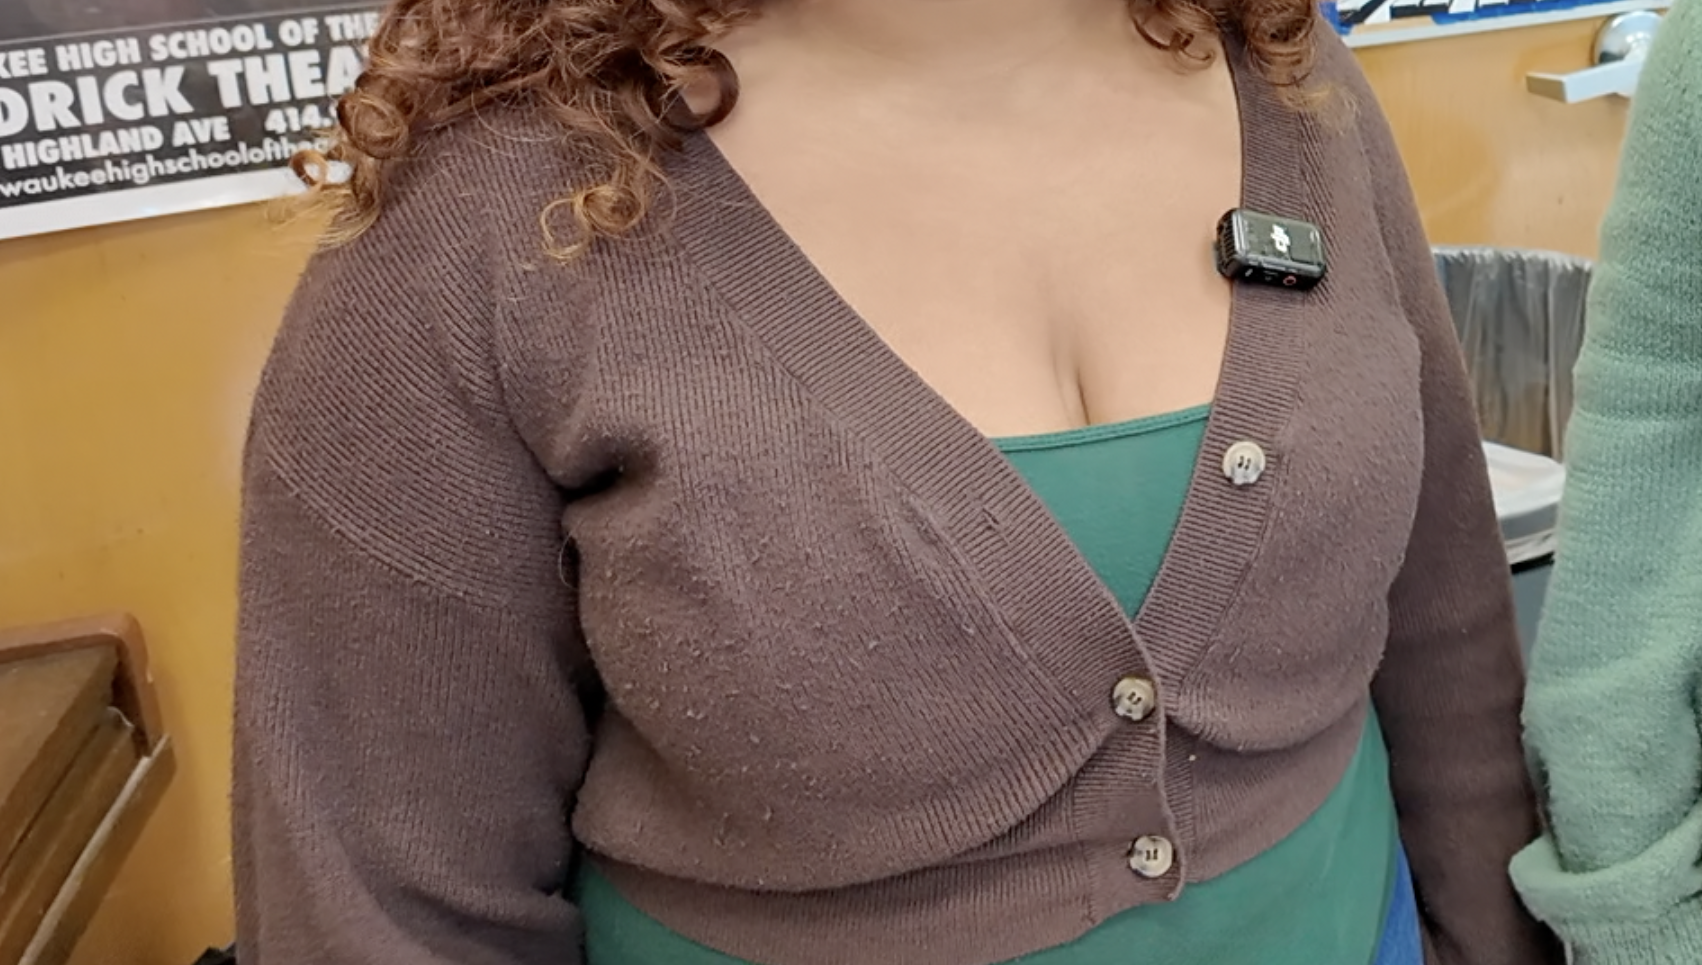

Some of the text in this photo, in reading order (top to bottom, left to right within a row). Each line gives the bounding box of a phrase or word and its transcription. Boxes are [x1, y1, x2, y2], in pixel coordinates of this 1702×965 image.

[55, 38, 142, 72] HIGH
[149, 22, 273, 62] SCHOOL
[278, 18, 319, 48] OF
[0, 44, 367, 136] DRICK THEA
[1, 105, 338, 170] HIGHLAND AVE 414.
